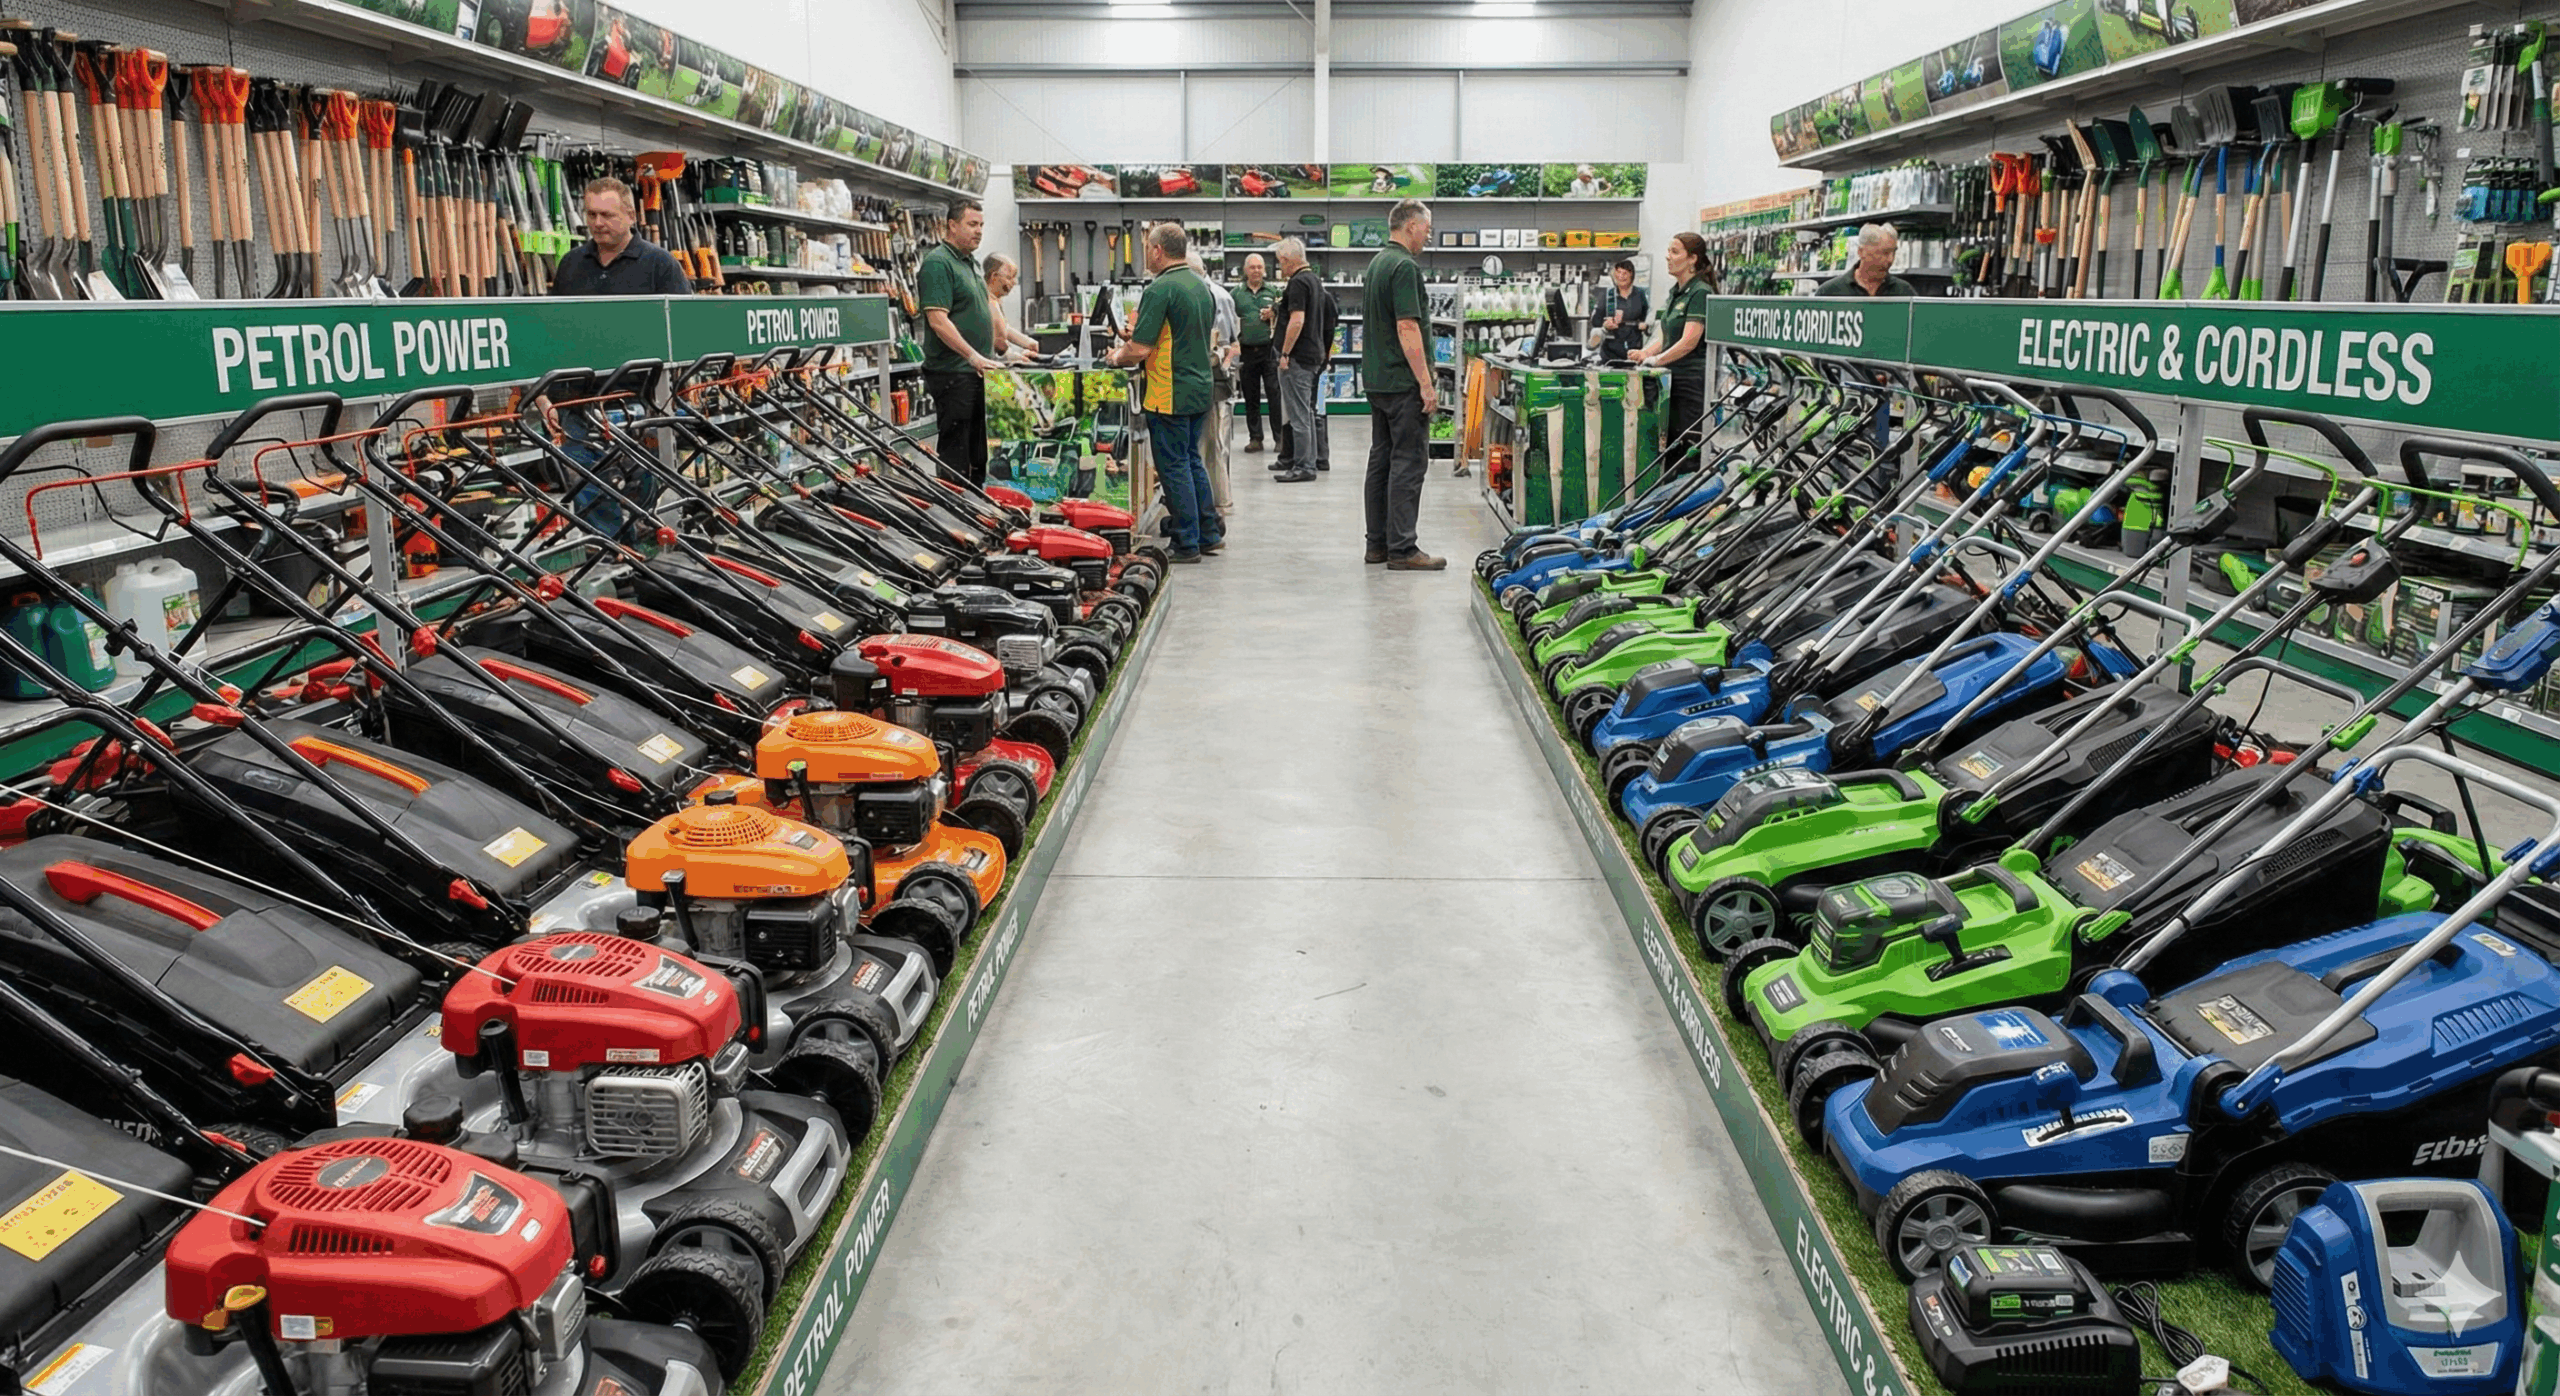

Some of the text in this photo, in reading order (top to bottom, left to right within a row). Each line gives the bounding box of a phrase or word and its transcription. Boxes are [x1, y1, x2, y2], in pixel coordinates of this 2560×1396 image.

[212, 317, 511, 393] PETROL POWER
[746, 307, 841, 345] PETROL POWER
[1734, 307, 1863, 348] ELECTRIC & CORDLESS
[2018, 318, 2433, 405] ELECTRIC & CORDLESS
[967, 907, 1018, 1032] PETROL POWER
[1643, 917, 1673, 994] ELECTRIC
[1679, 989, 1721, 1090] CORDLESS
[845, 1178, 890, 1296] POWER
[1797, 1216, 1877, 1396] ELECTRIC &
